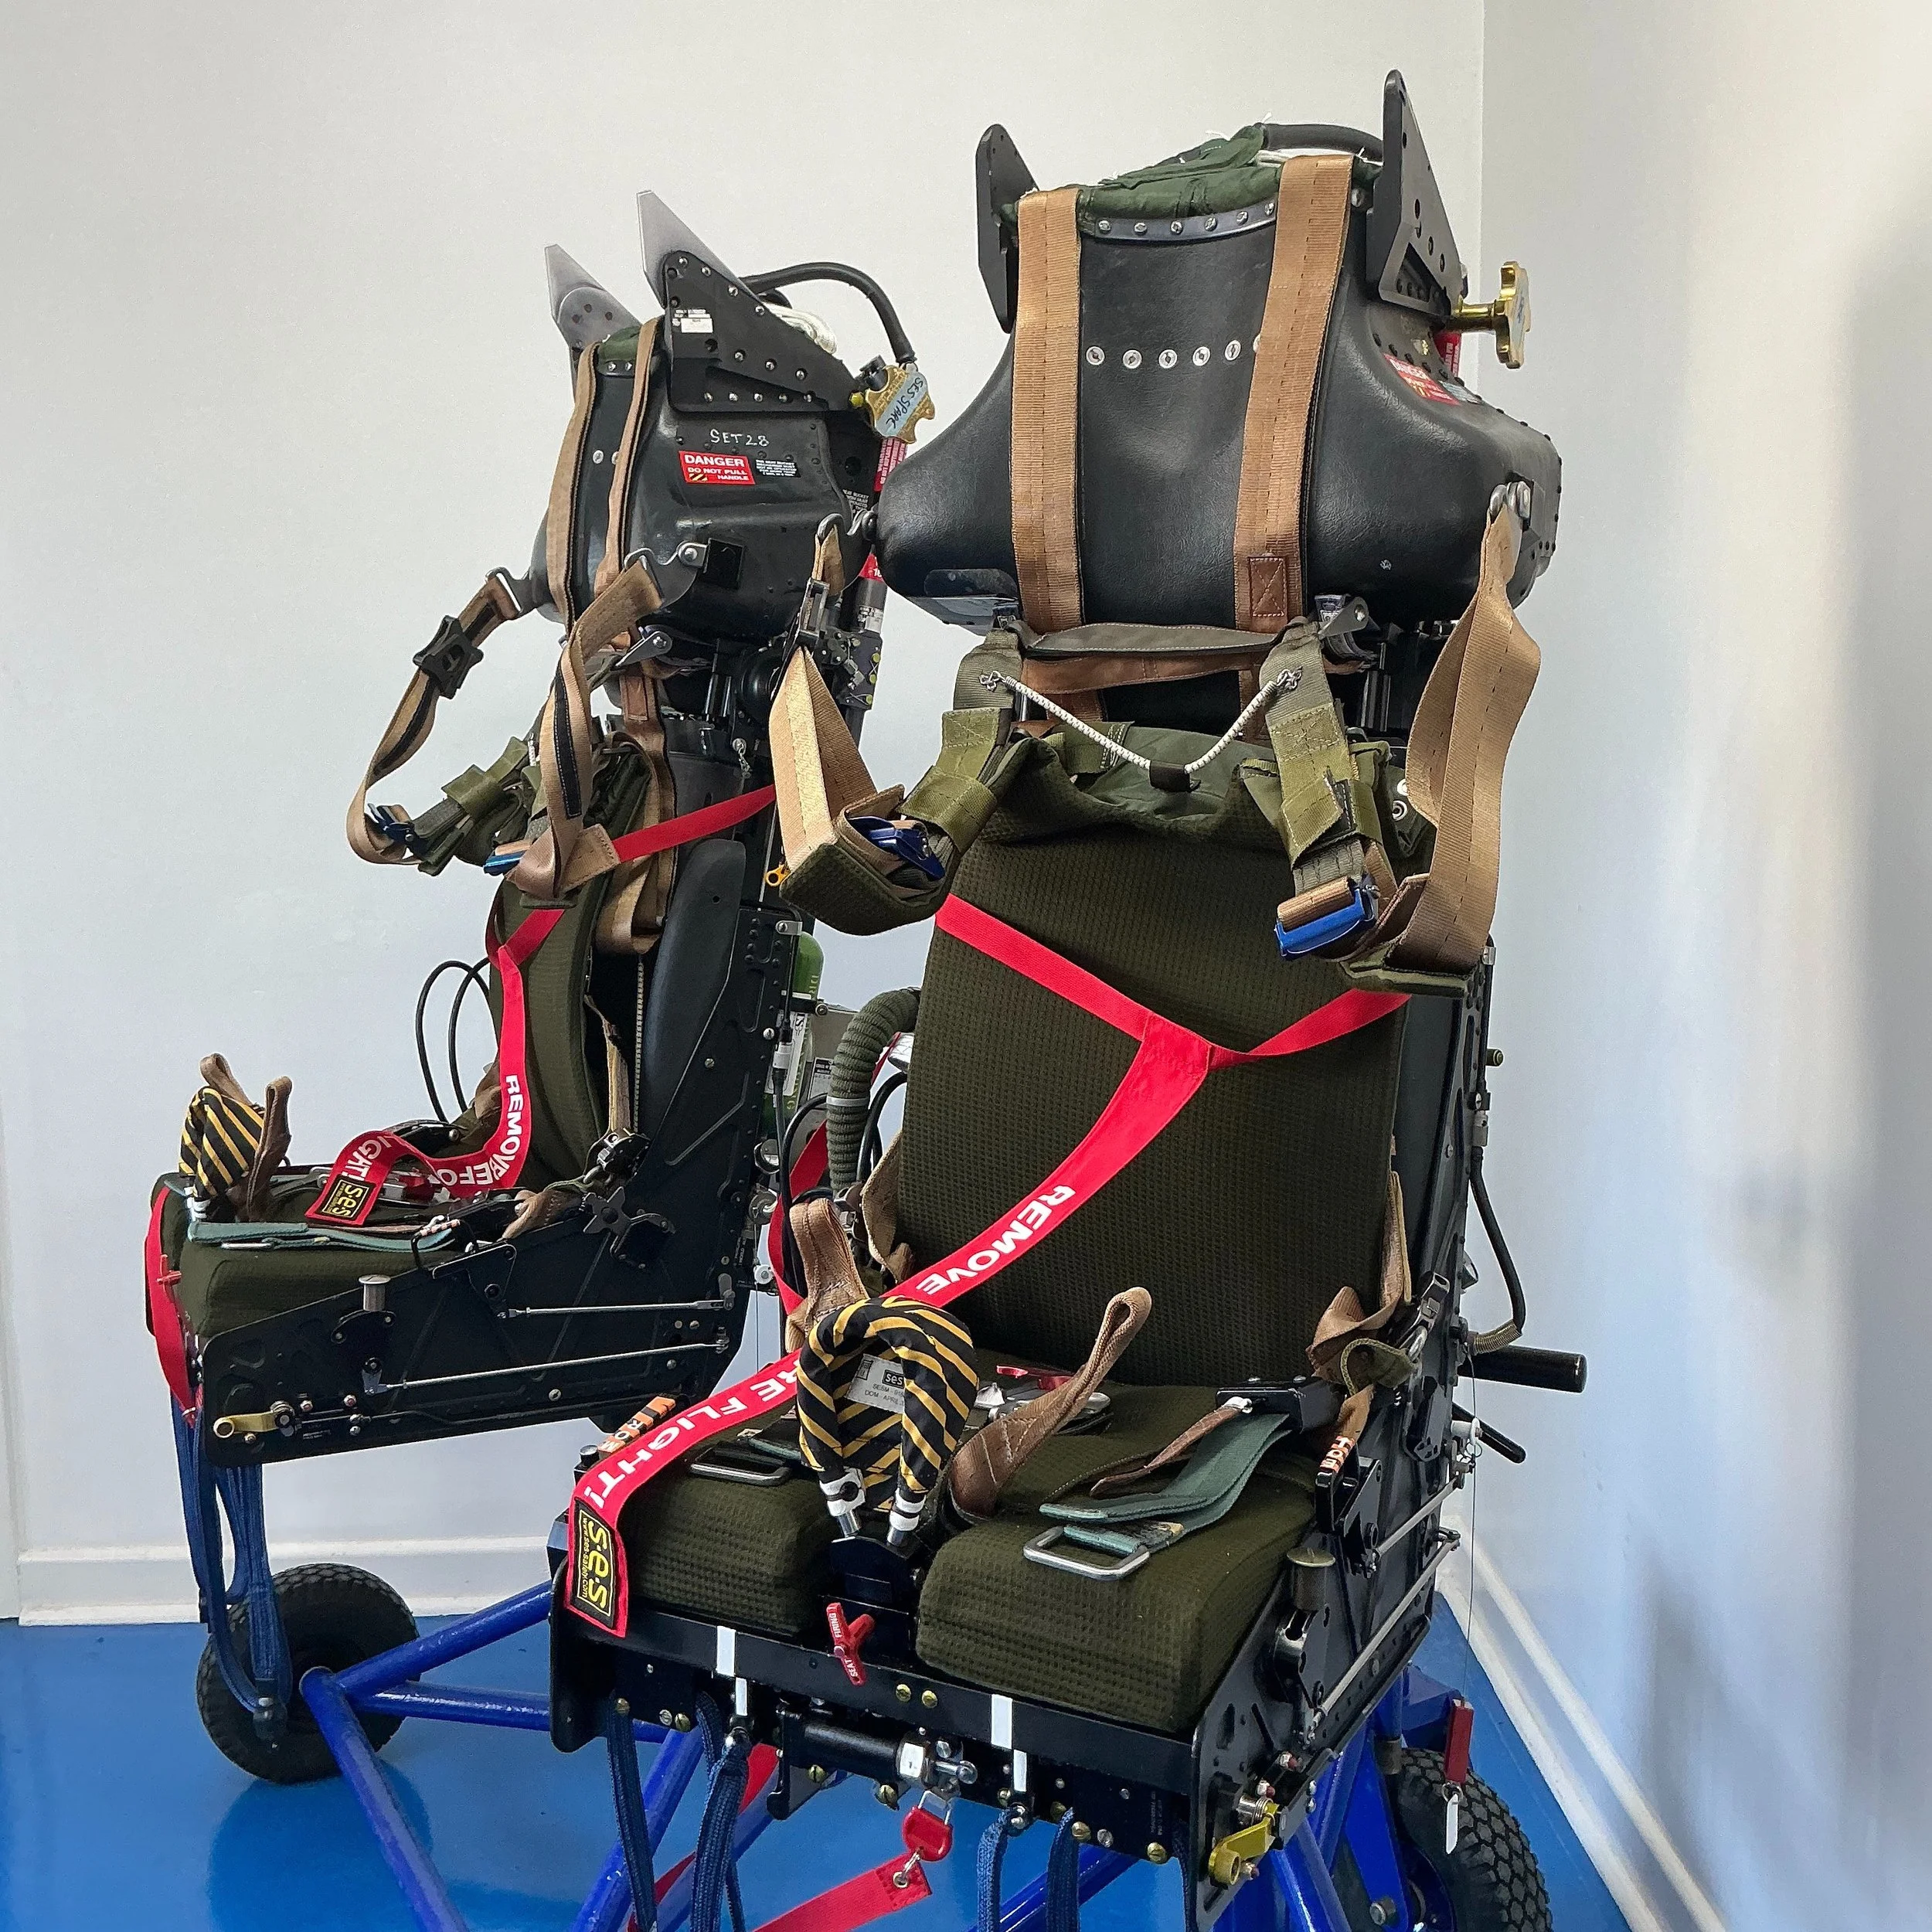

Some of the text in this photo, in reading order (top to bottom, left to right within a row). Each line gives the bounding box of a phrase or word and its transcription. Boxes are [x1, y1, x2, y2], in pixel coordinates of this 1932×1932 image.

[709, 429, 770, 447] SET 28
[684, 454, 745, 468] DANGER
[915, 1184, 1077, 1296] REMOVE
[885, 1373, 903, 1386] ses
[583, 1396, 749, 1509] FLIGHT!
[828, 1611, 859, 1678] SEAT FIRING
